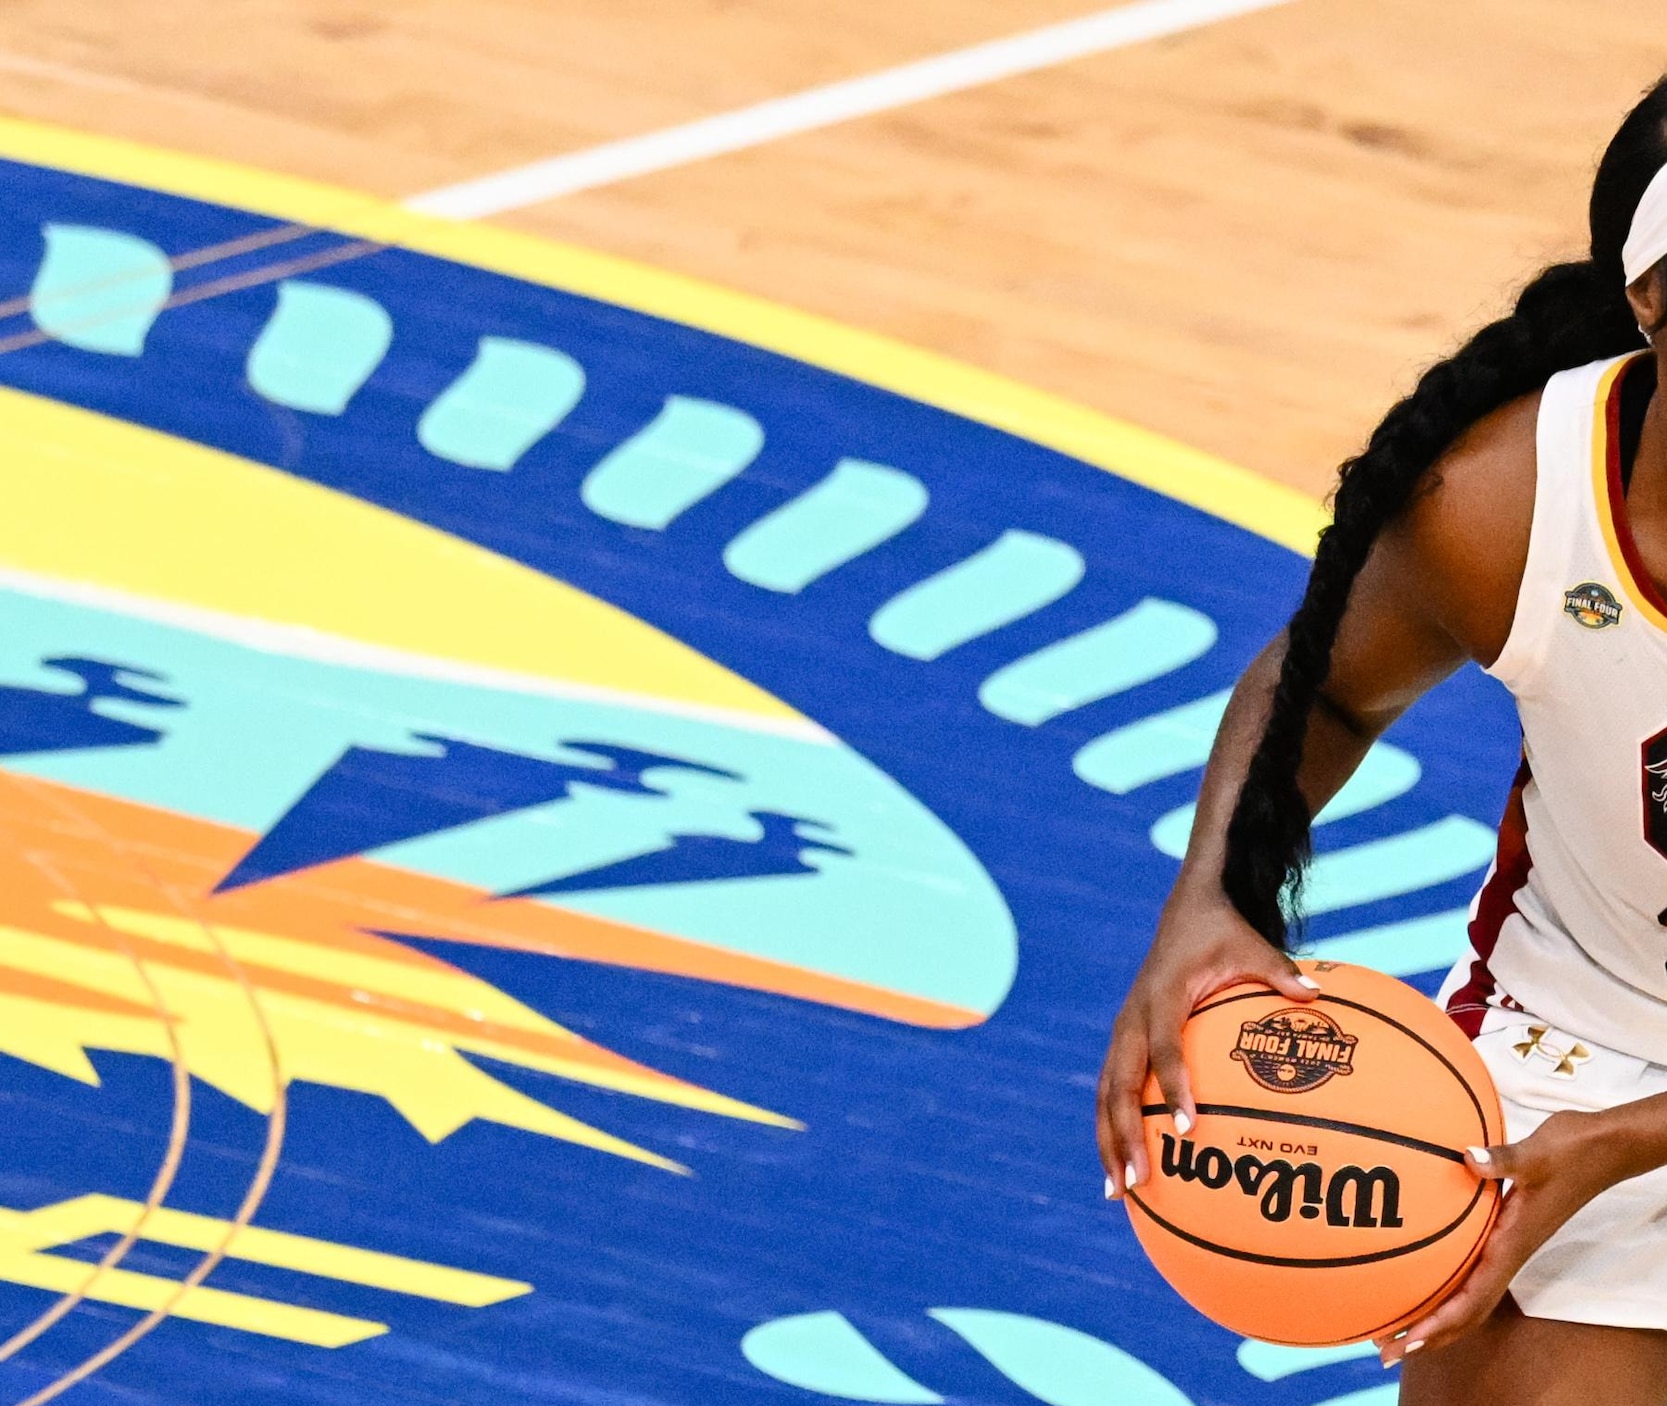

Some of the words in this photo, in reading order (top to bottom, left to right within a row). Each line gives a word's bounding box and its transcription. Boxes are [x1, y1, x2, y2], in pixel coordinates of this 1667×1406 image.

[1566, 597, 1592, 610] FINAL
[1594, 601, 1619, 618] FOUR
[1239, 1031, 1291, 1054] FOUR
[1295, 1039, 1352, 1063] FINAL
[1236, 1136, 1274, 1151] NXT
[1280, 1142, 1319, 1157] EVO
[1161, 1133, 1404, 1229] Wilson
